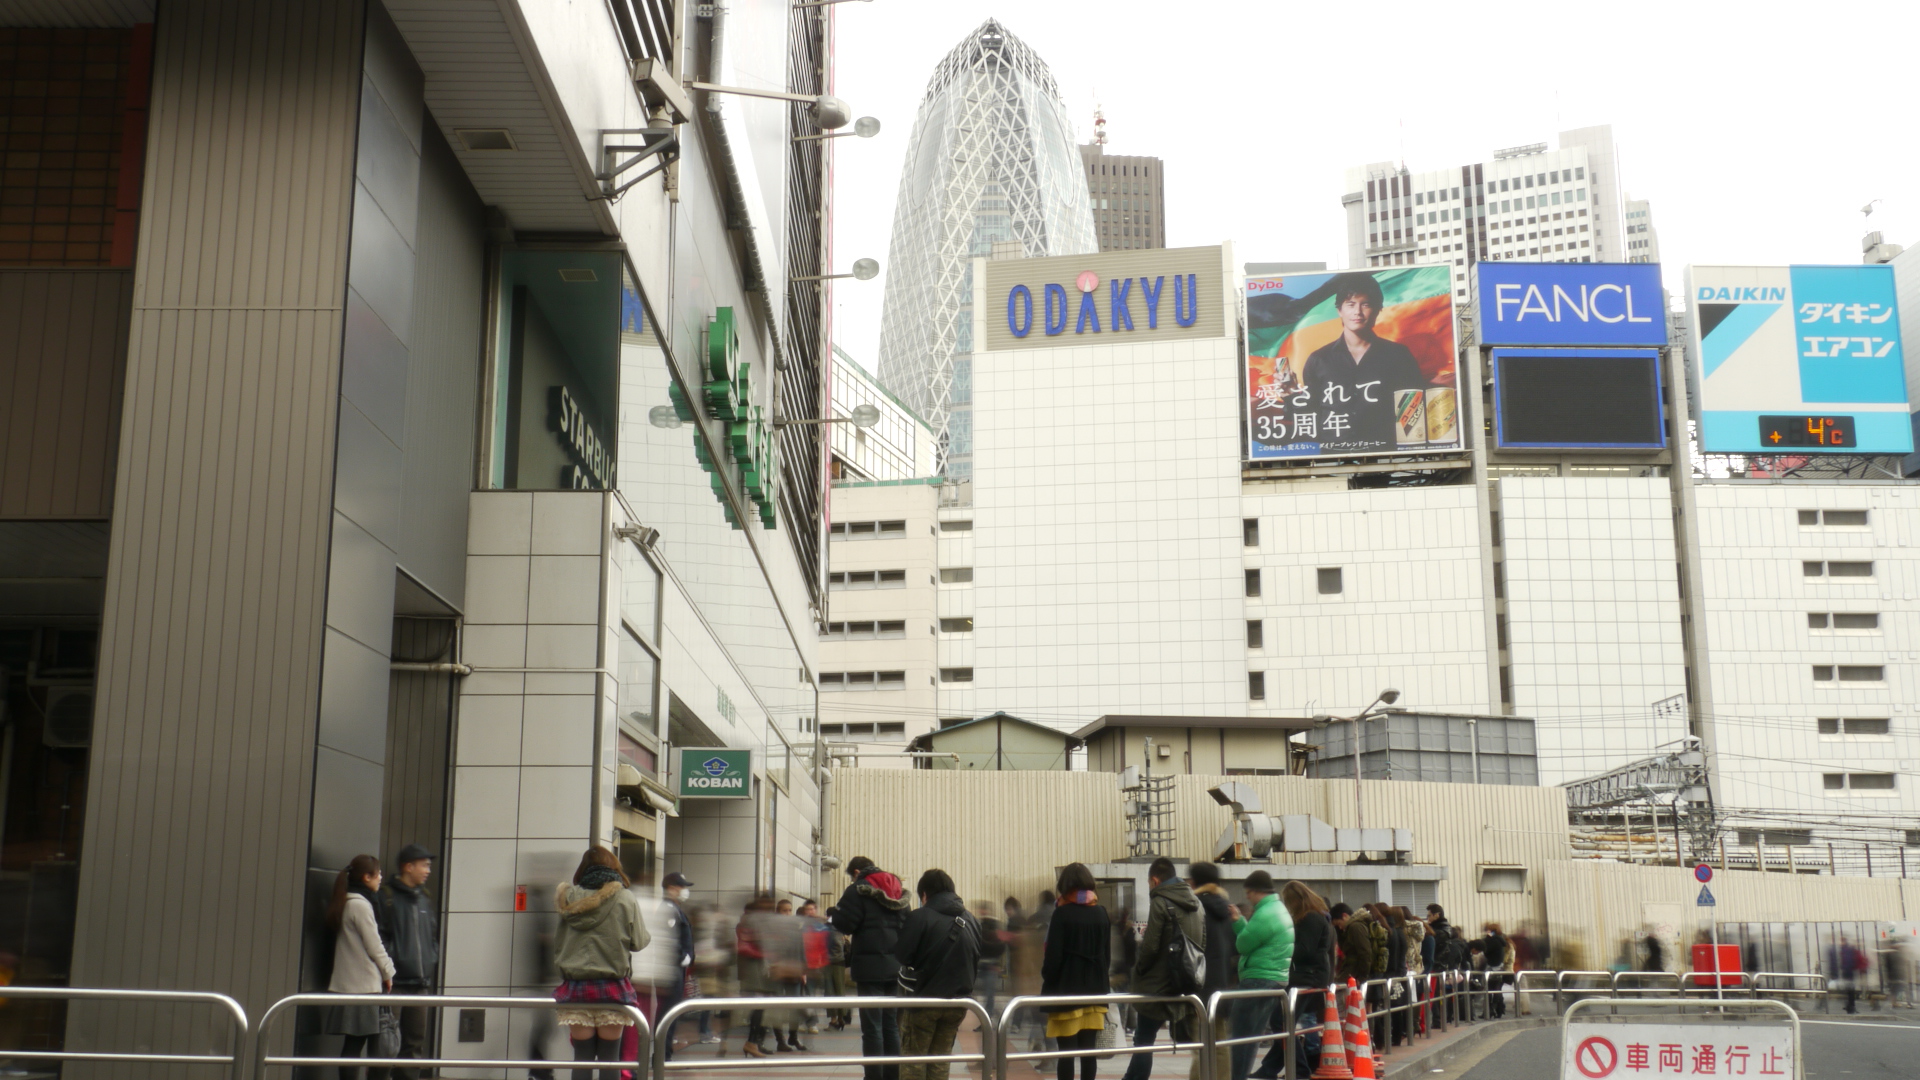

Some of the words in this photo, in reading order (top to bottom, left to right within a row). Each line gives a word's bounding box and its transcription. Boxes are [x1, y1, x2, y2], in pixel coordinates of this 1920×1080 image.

[1247, 281, 1284, 292] DyDo
[1697, 287, 1786, 301] DAIKIN
[1007, 270, 1198, 338] ODAKYU
[1495, 283, 1652, 323] FANCL
[1799, 303, 1893, 325] ダイキン
[1802, 336, 1896, 358] エアコン
[1256, 380, 1382, 410] 愛されて
[1257, 411, 1351, 440] 35周年
[687, 777, 742, 788] KOBAN
[1625, 1042, 1785, 1075] 車両通行止
